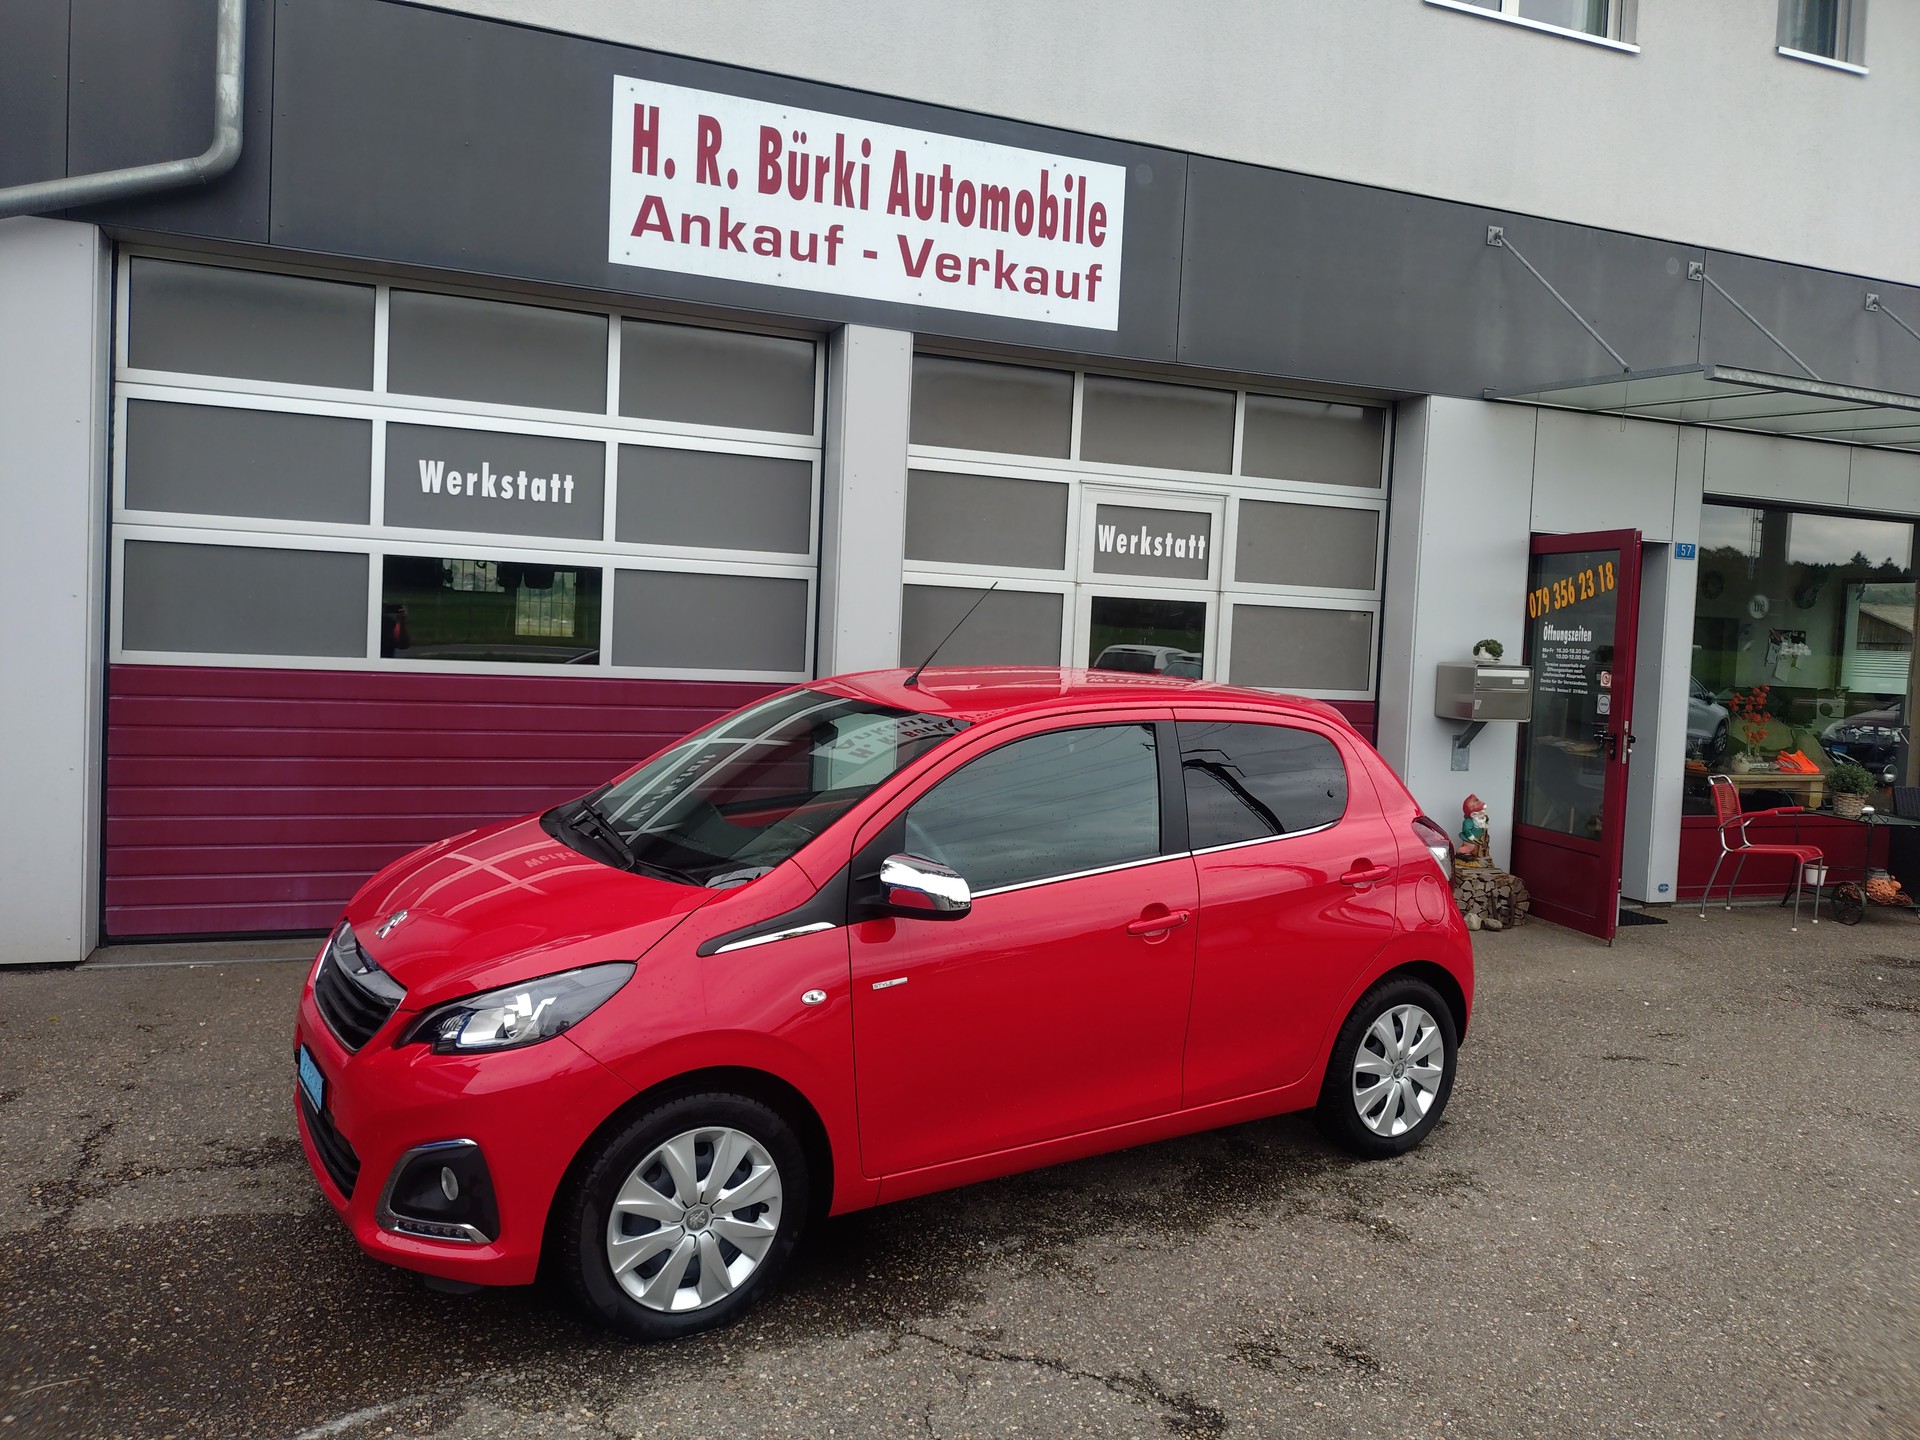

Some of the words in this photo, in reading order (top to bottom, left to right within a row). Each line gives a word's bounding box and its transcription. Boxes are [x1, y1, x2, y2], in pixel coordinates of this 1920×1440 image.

[632, 103, 676, 180] H.
[696, 114, 738, 190] R.
[757, 125, 872, 211] Bürki
[886, 149, 1108, 248] Automobile
[630, 194, 844, 266] Ankauf
[896, 234, 1103, 302] Verkauf
[418, 459, 575, 504] Werkstatt
[1098, 524, 1206, 560] Werkstatt
[1681, 544, 1692, 557] 57
[1528, 586, 1550, 619] 079
[1553, 576, 1576, 610] 356
[1578, 569, 1595, 601] 23
[1598, 561, 1615, 593] 18
[1543, 622, 1592, 644] Öffnungszeiten
